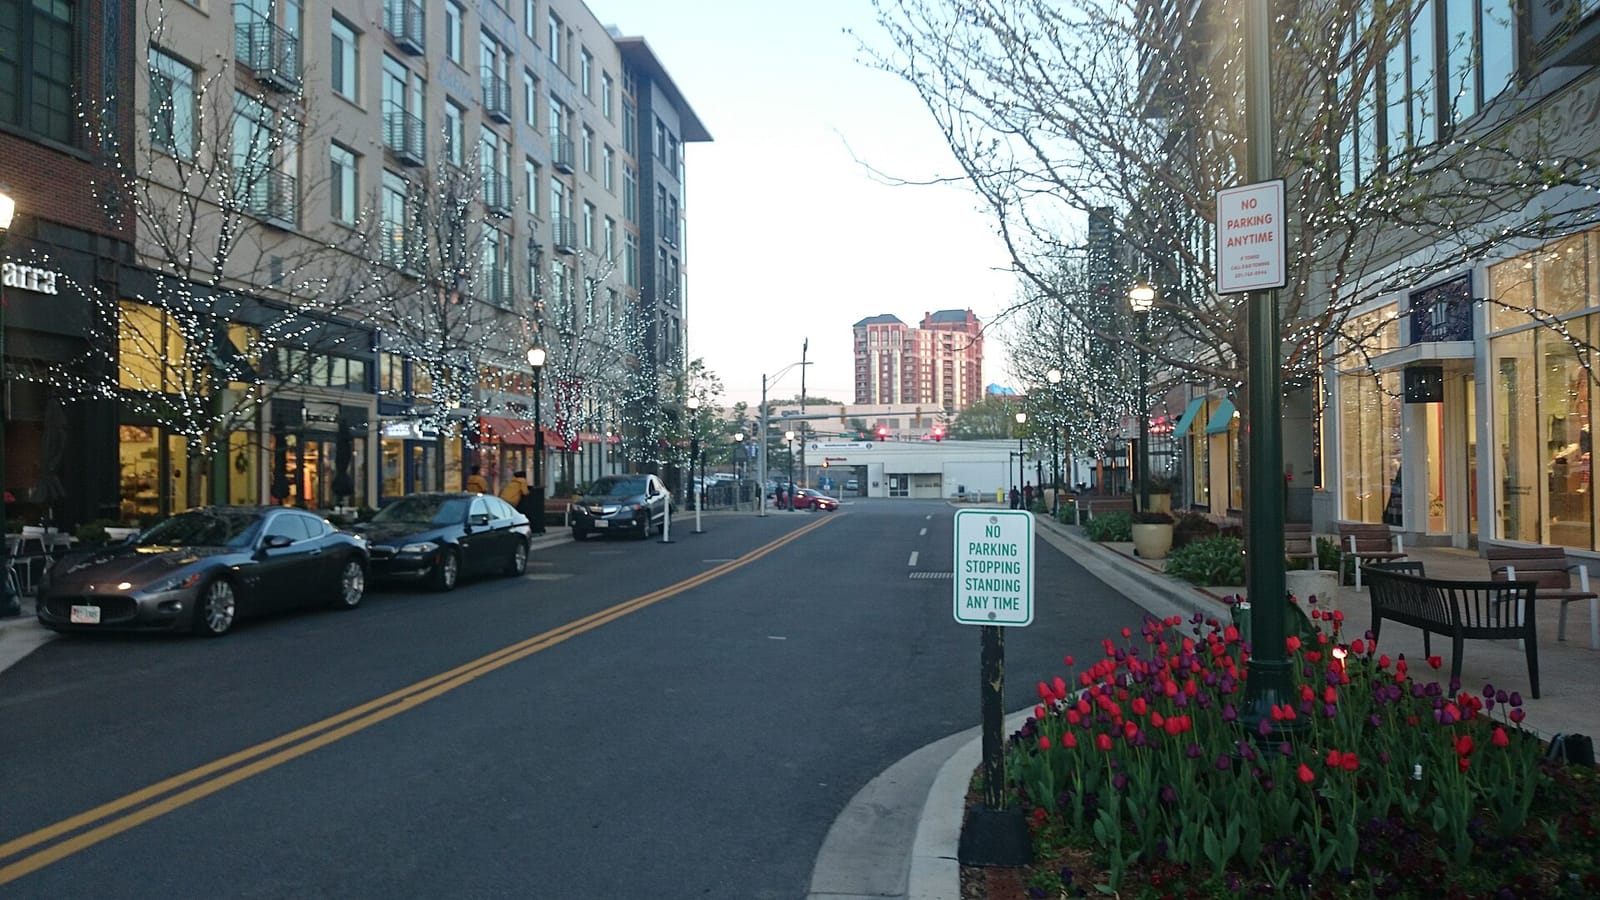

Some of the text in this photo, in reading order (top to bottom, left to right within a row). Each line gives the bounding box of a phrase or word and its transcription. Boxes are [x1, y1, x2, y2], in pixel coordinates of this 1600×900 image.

[1241, 198, 1257, 210] NO
[1227, 213, 1272, 230] PARKING
[1227, 231, 1273, 248] ANYTIME
[985, 525, 1001, 538] NO
[969, 542, 1017, 557] PARKING
[966, 560, 1021, 574] STOPPING
[965, 577, 1021, 592] STANDING
[966, 595, 1020, 610] ANY TIME
